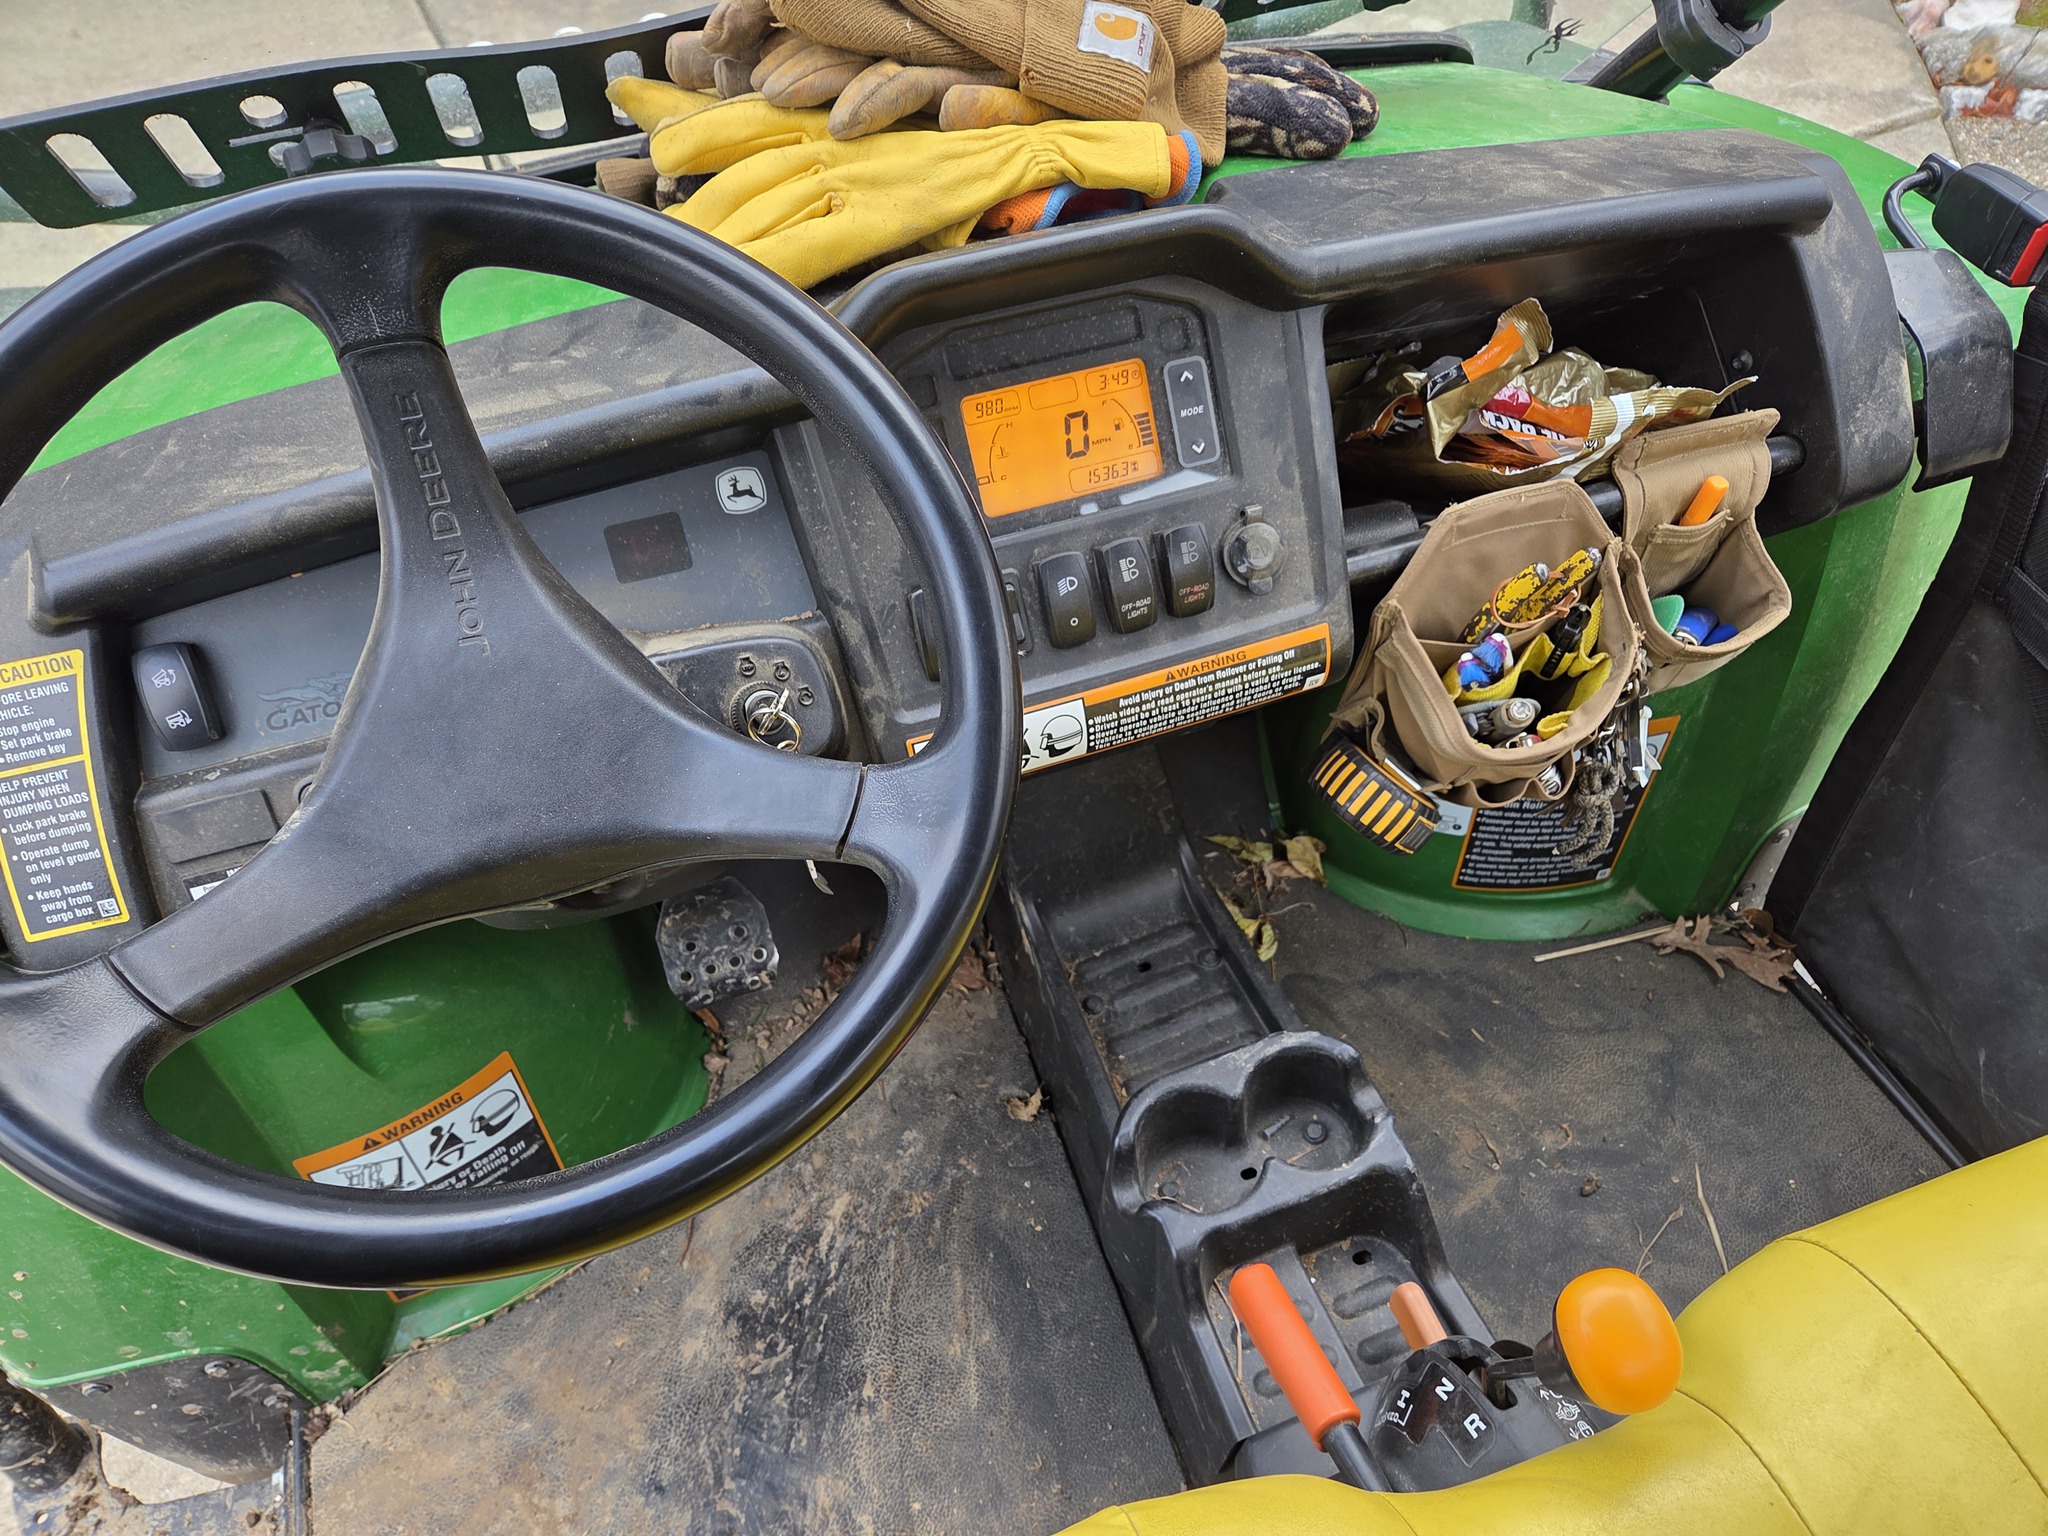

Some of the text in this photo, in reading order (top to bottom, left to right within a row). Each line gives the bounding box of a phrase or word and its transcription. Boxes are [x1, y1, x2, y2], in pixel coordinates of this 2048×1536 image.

[1137, 23, 1147, 56] carhartt
[1100, 369, 1128, 390] 3:49
[976, 398, 1004, 418] 980
[1180, 405, 1204, 418] MODE
[1064, 410, 1112, 459] 0 MPH
[1088, 461, 1129, 484] 1536.3
[395, 390, 490, 656] JOHN DEERE
[1179, 582, 1210, 596] OFF-ROAD
[1184, 592, 1205, 604] LIGHTS
[1121, 596, 1151, 612] OFF-ROAD
[1128, 606, 1148, 619] LIGHTS
[0, 655, 74, 683] CAUTION
[1177, 650, 1246, 677] WARNING
[1118, 648, 1294, 708] Avoid Injury or Death from Rollover or Falling Off
[0, 682, 70, 705] ORE LEAVING
[1094, 663, 1284, 725] Watch video and read operator's manual before use.
[1094, 719, 1118, 733] Driver
[1120, 713, 1138, 726] must
[1140, 710, 1149, 720] be
[1150, 707, 1158, 716] at
[1160, 701, 1179, 714] least
[1190, 693, 1212, 706] years
[1213, 688, 1226, 698] old
[1226, 683, 1242, 694] with
[1250, 674, 1269, 687] valid
[1270, 668, 1292, 681] driver
[1292, 659, 1321, 675] license.
[0, 705, 34, 720] HICLE:
[266, 701, 343, 731] GATO
[21, 718, 56, 732] engine
[0, 728, 72, 750] Set park brake
[5, 743, 66, 764] Remove key
[22, 770, 68, 788] PREVENT
[38, 782, 70, 798] WHEN
[3, 792, 89, 818] DUMPING LOADS
[9, 810, 87, 833] Lock park brake
[14, 822, 92, 846] before dumping
[20, 840, 90, 861] Operate dump
[26, 848, 101, 874] on level ground
[30, 873, 52, 885] only
[36, 880, 94, 900] Keep hands
[40, 894, 92, 912] away from
[46, 906, 94, 924] cargo box
[381, 1092, 463, 1141] WARNING
[458, 1166, 472, 1179] or
[472, 1146, 507, 1170] Death
[469, 1154, 509, 1182] Falling
[510, 1140, 526, 1156] Off
[1396, 1390, 1410, 1408] H
[1434, 1376, 1455, 1402] N
[1463, 1412, 1488, 1439] R
